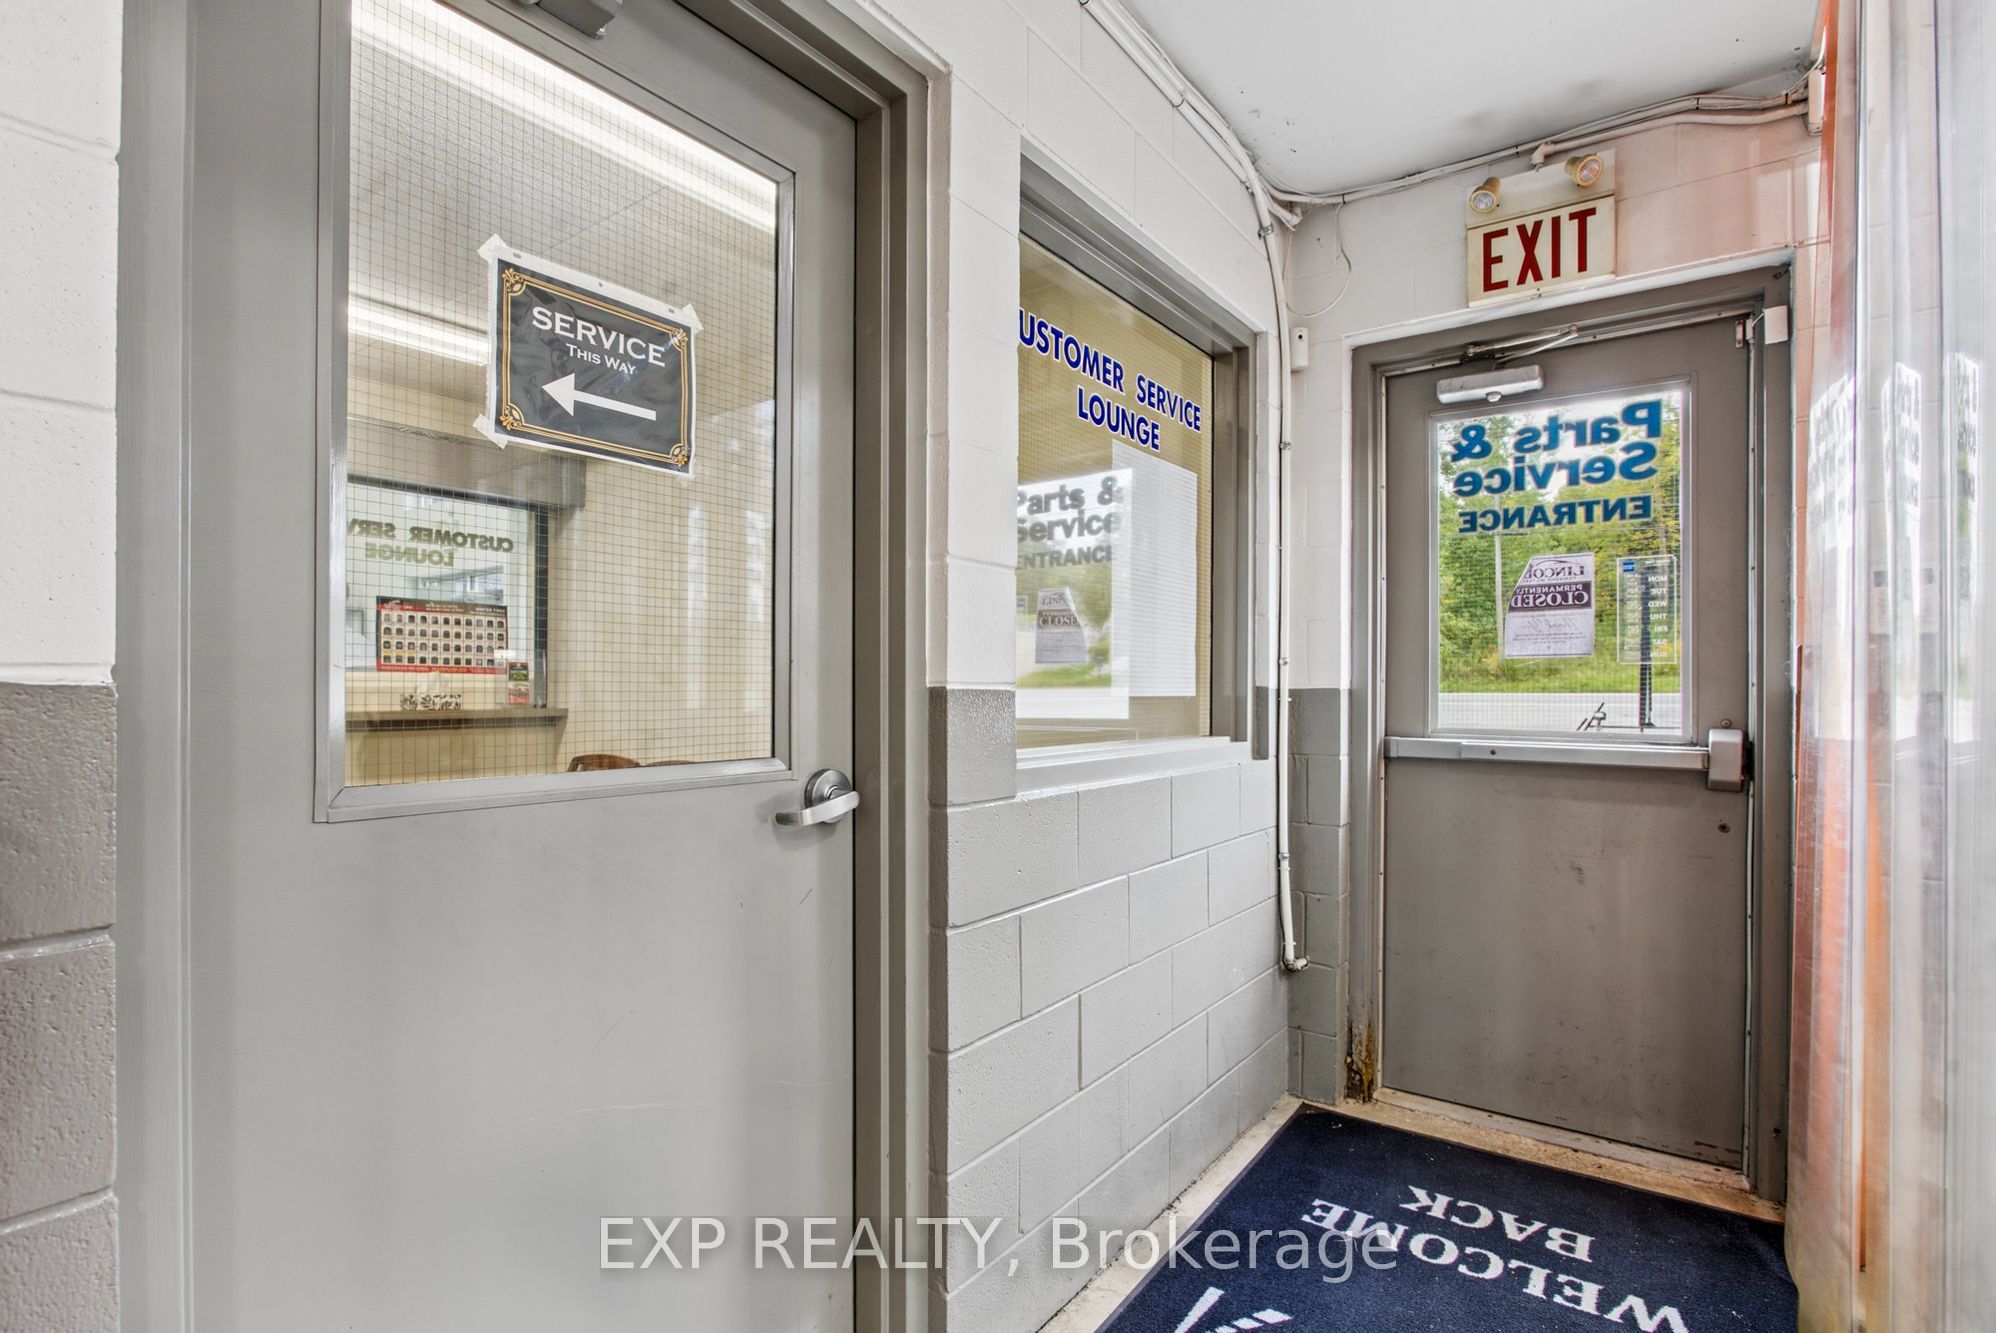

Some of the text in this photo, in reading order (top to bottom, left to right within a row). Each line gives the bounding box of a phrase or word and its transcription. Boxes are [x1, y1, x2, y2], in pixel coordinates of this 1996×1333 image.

[1483, 207, 1597, 292] EXIT
[532, 306, 666, 368] SERVICE
[565, 343, 637, 375] THIS WAY
[1019, 307, 1201, 432] USTOMER SERVICE
[1077, 385, 1161, 452] LOUNGE
[1097, 475, 1124, 505] &
[1040, 616, 1078, 627] CLOSE
[1401, 1185, 1596, 1263] BACK
[1301, 1199, 1688, 1333] WELCOME
